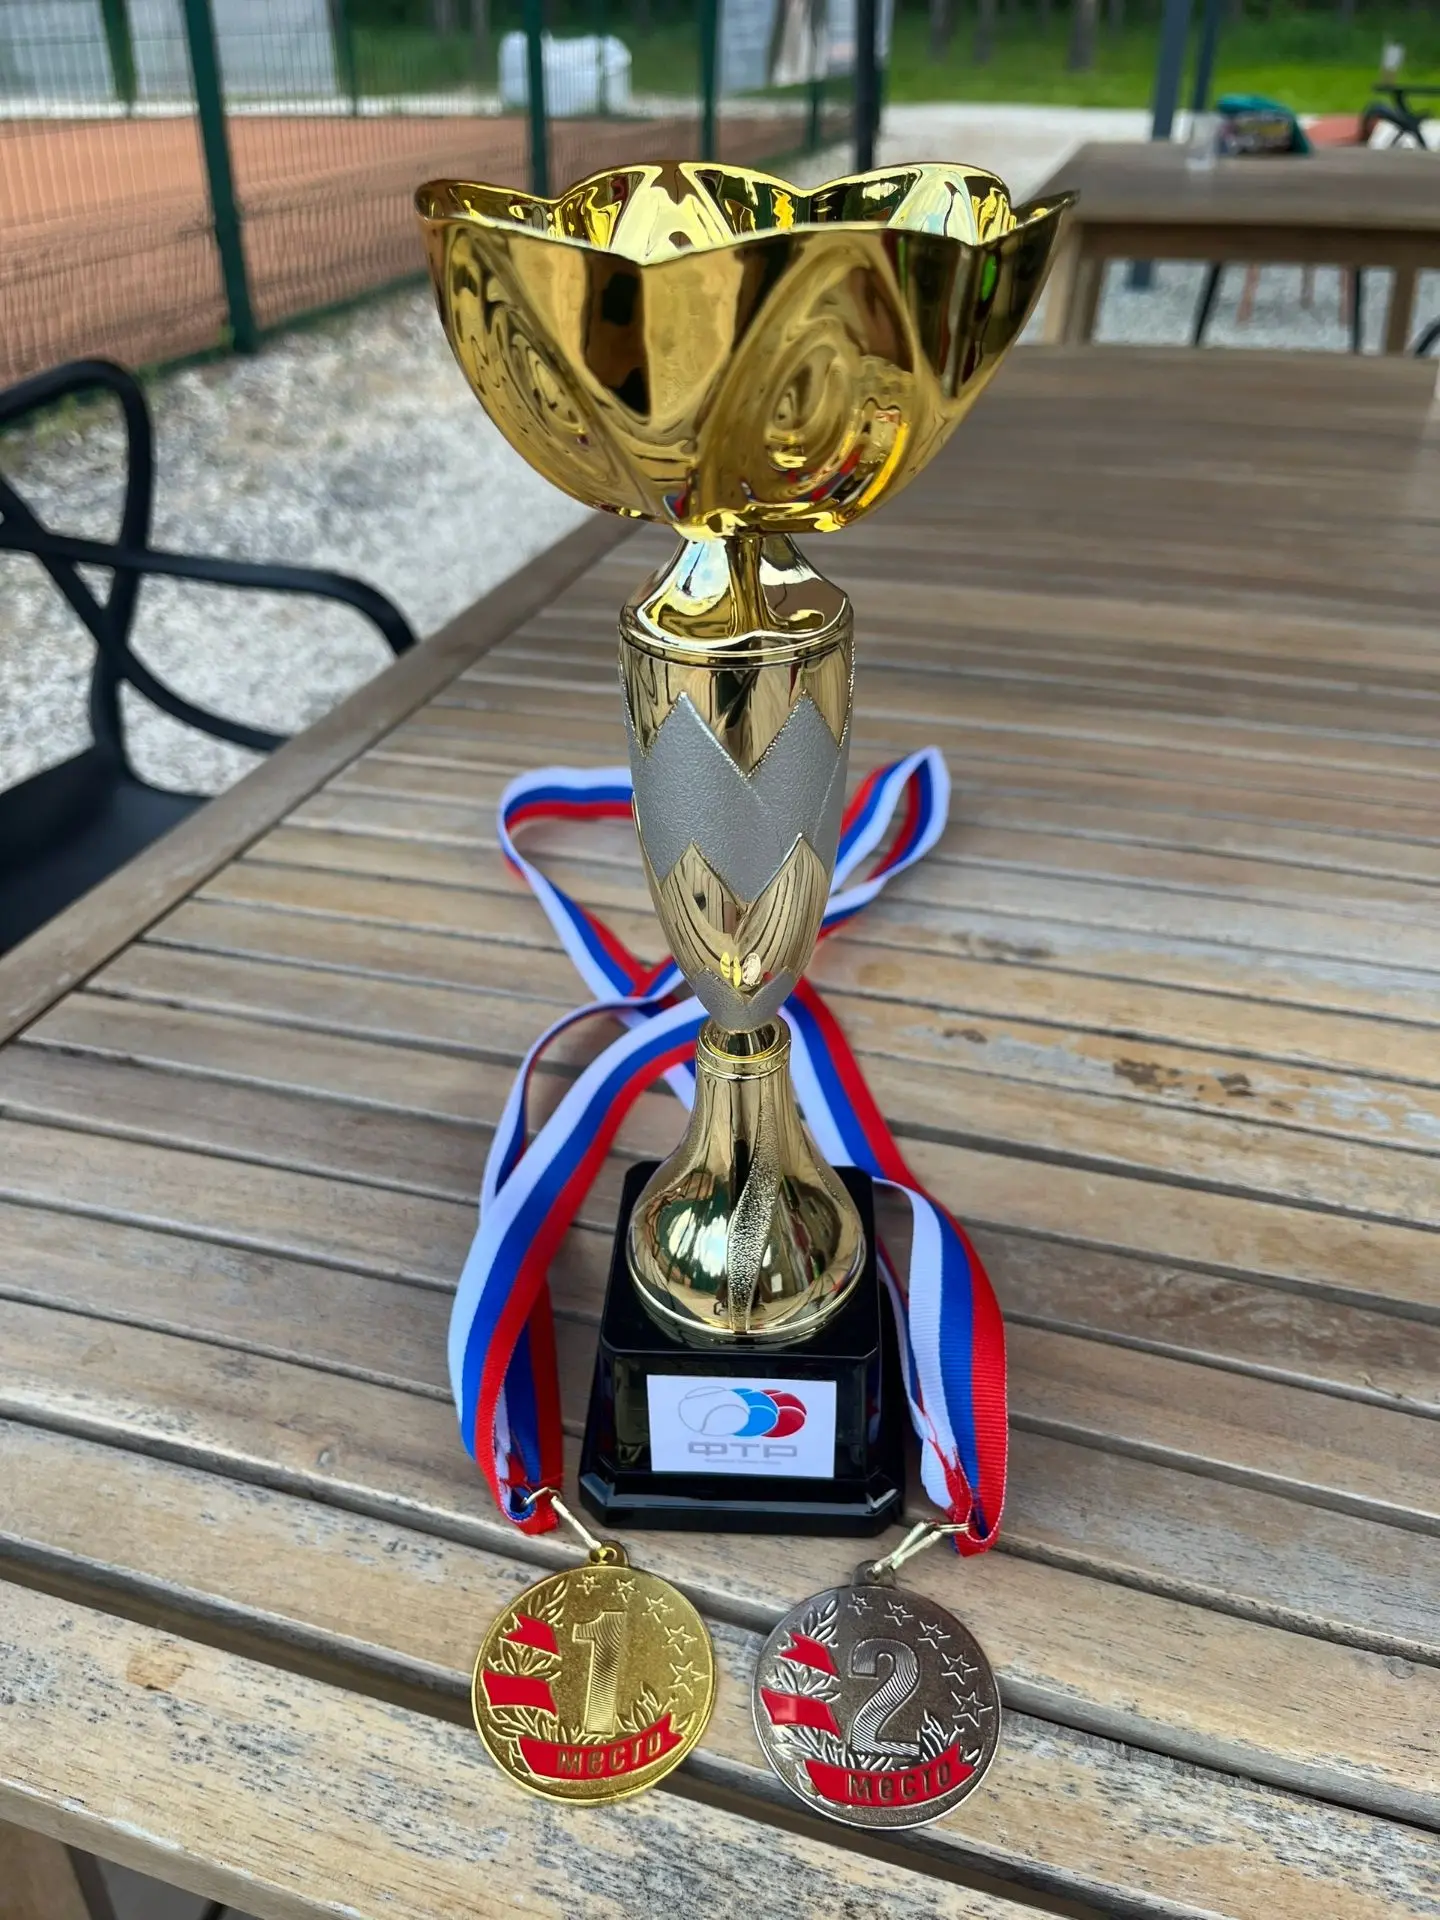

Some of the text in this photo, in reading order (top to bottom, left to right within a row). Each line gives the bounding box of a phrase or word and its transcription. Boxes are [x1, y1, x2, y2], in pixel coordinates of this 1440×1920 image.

[687, 1441, 798, 1459] ФТР
[571, 1611, 626, 1736] 1
[849, 1637, 921, 1757] 2
